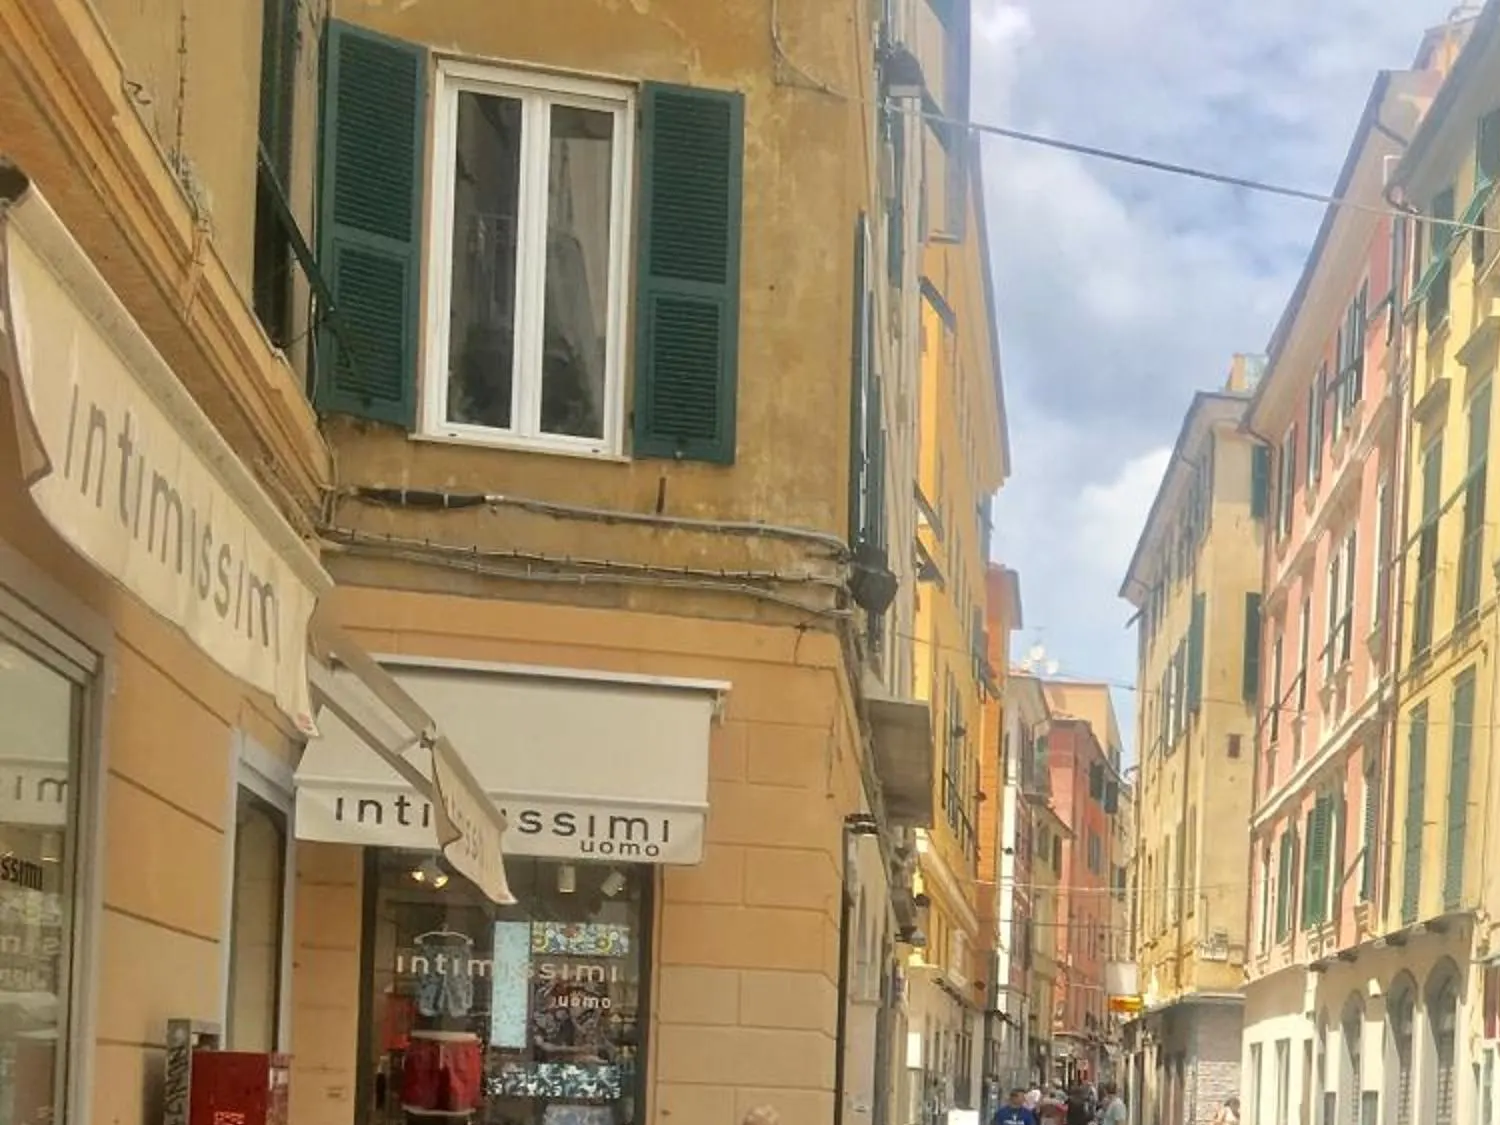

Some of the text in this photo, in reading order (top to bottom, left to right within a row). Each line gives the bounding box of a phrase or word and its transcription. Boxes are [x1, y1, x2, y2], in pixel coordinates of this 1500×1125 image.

[335, 795, 669, 842] intissimi
[580, 840, 660, 857] uomo
[396, 952, 618, 982] intimssimi
[558, 996, 611, 1009] uomo
